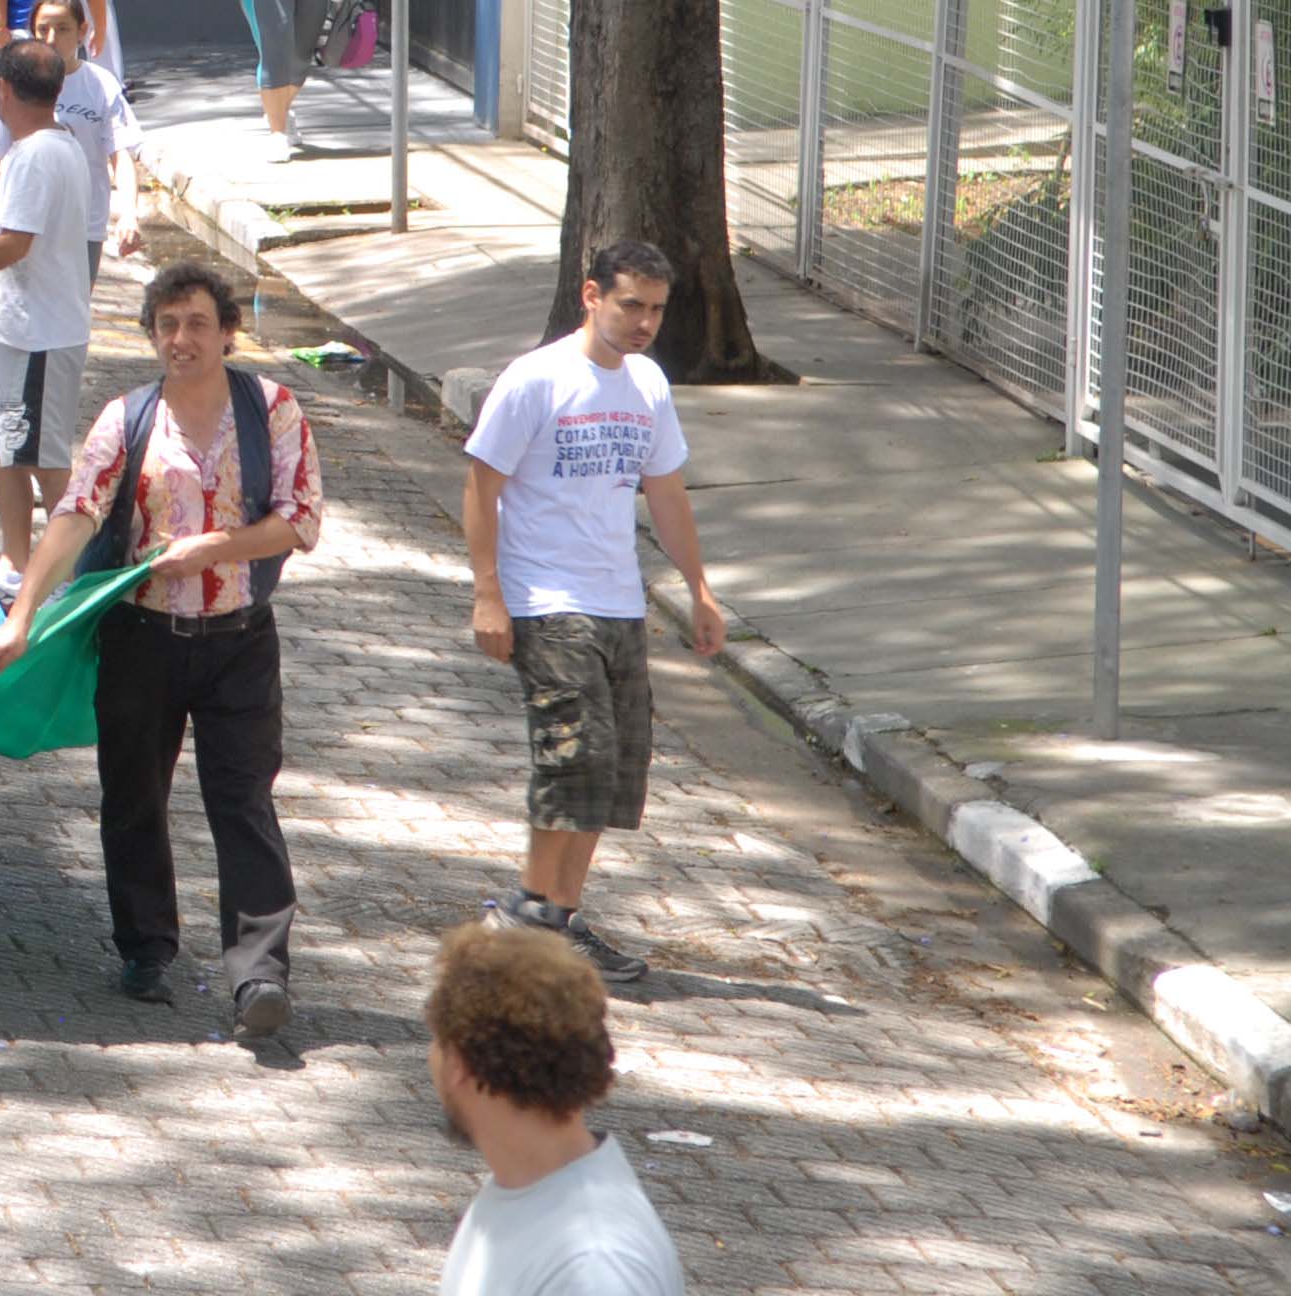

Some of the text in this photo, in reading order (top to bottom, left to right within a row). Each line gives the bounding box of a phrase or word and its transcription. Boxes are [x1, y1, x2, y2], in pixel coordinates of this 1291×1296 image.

[554, 427, 597, 444] COTAS
[600, 425, 639, 441] RACIAIS
[552, 461, 564, 478] A
[570, 461, 603, 477] HORA
